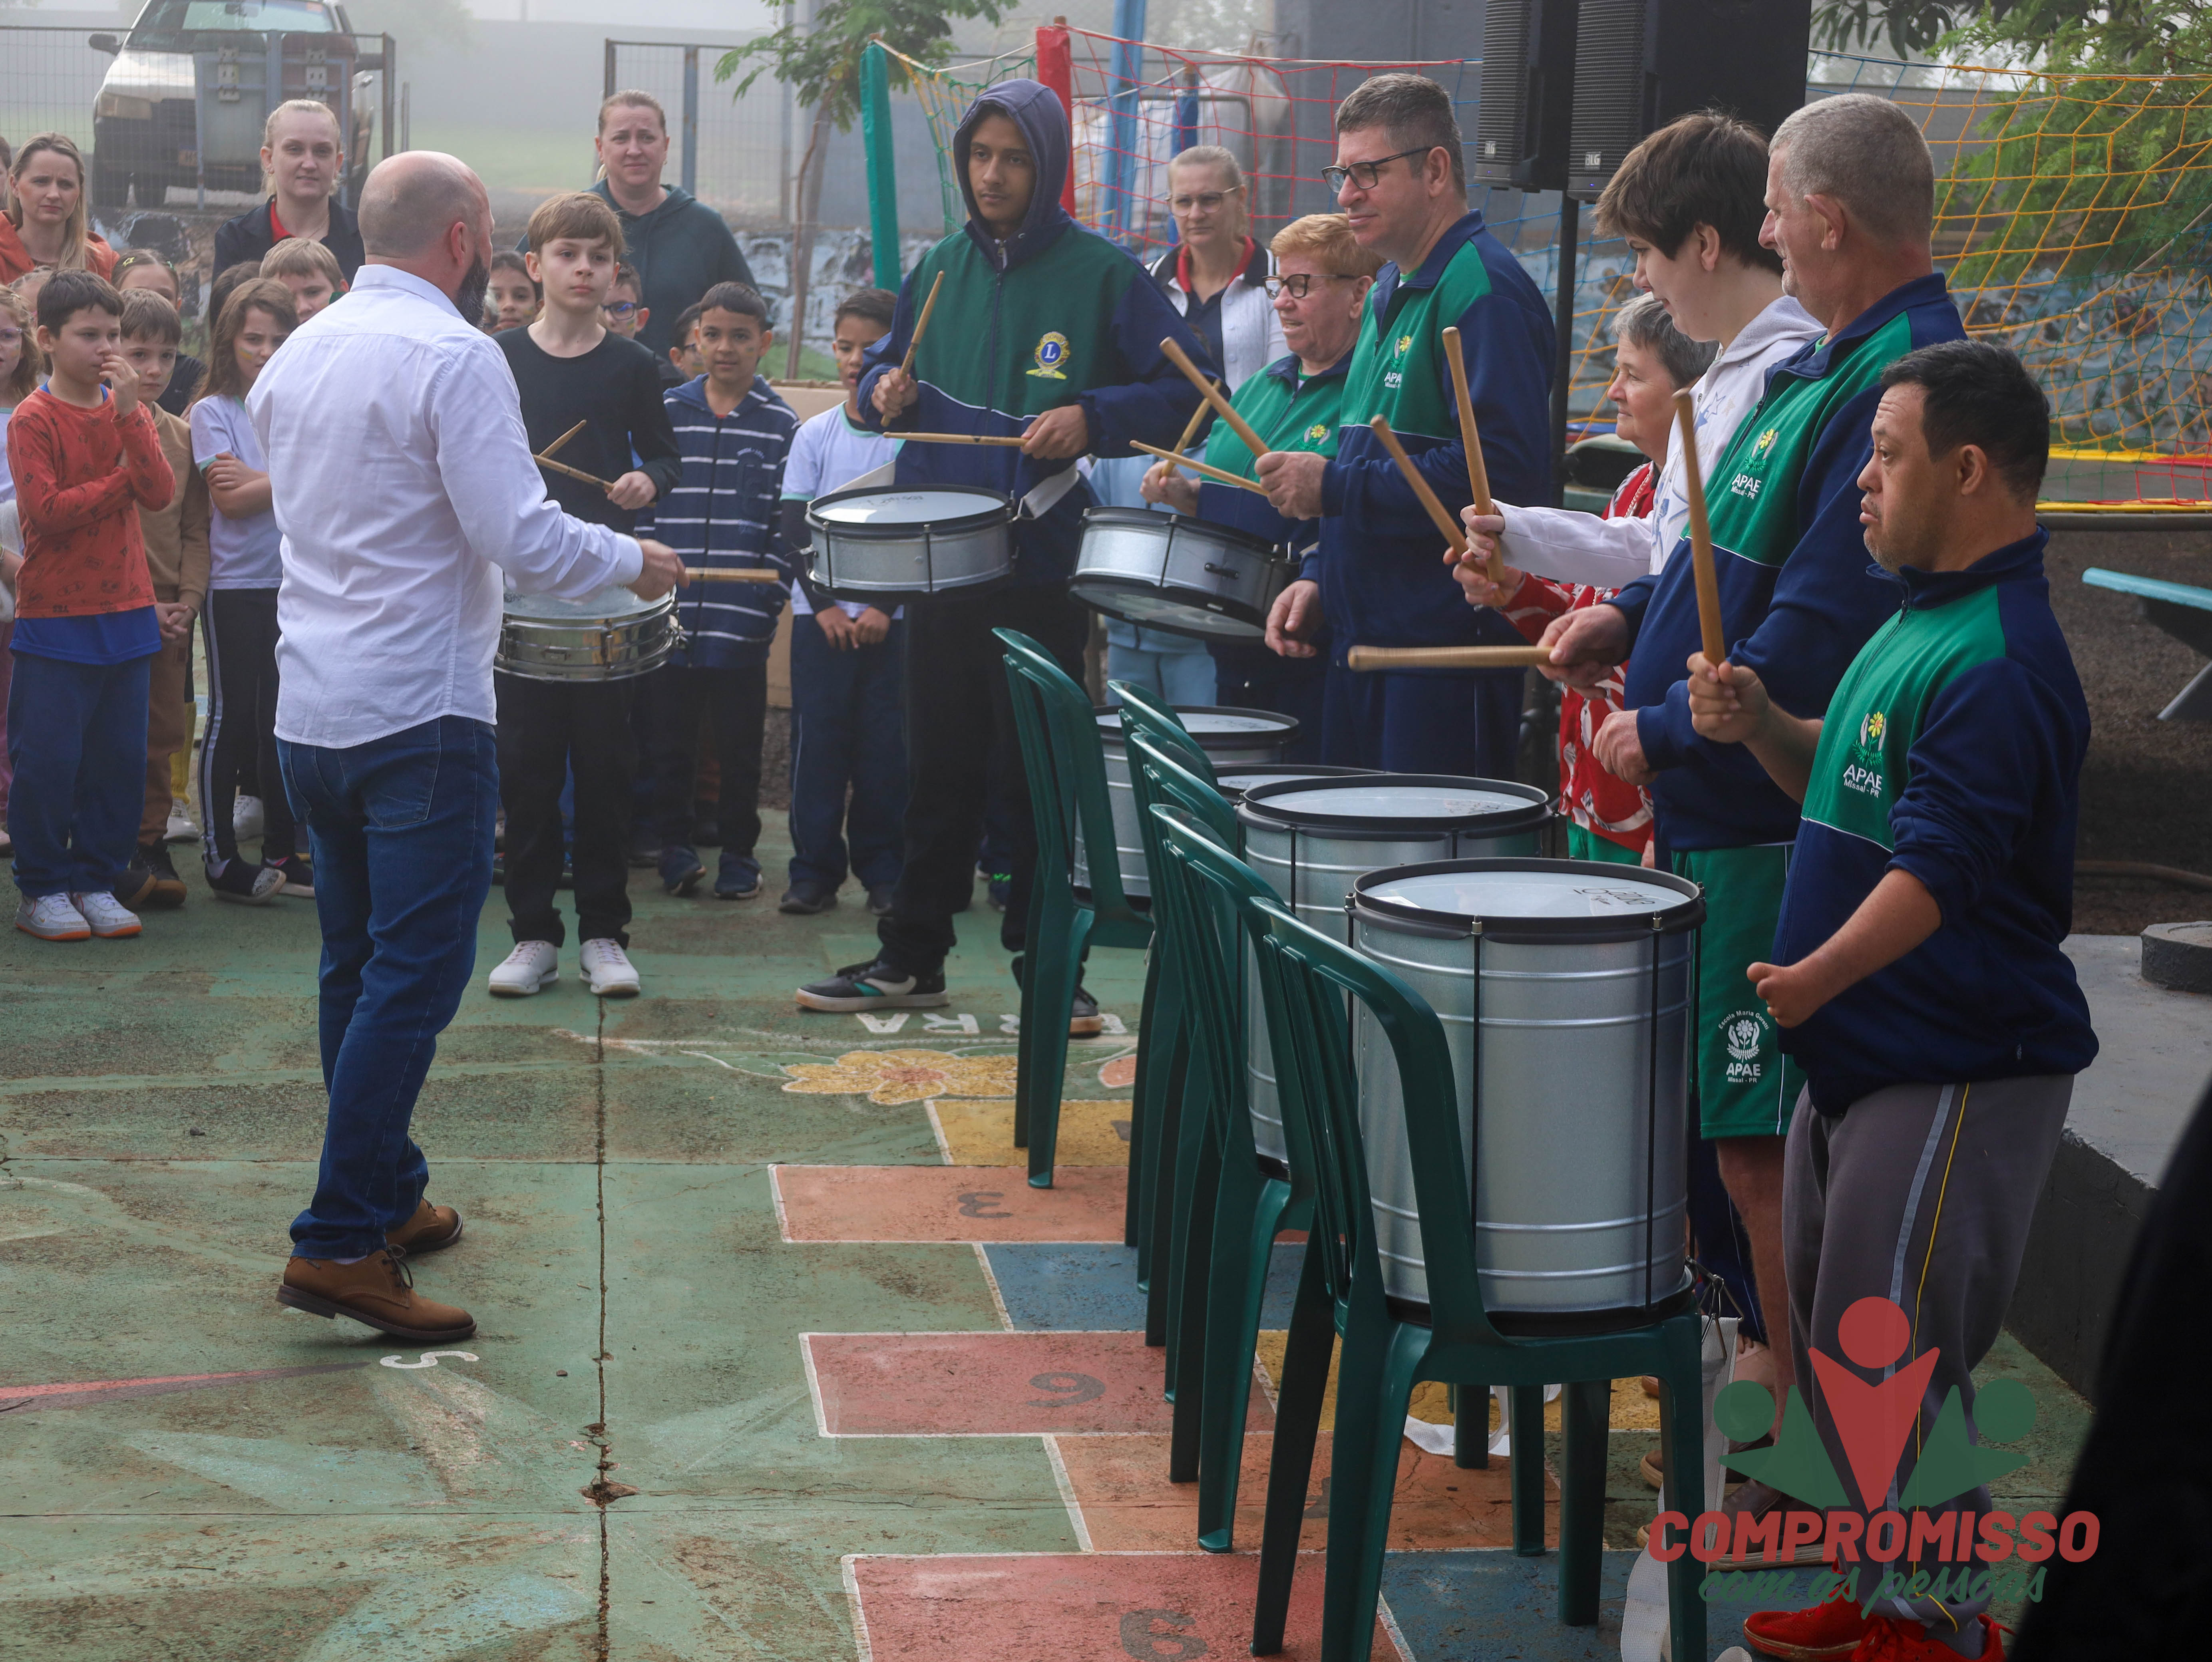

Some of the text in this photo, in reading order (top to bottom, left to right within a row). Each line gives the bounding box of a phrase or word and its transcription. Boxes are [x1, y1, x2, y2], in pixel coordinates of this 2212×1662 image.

[1044, 344, 1056, 359] L
[1732, 473, 1761, 493] APAE
[1731, 485, 1745, 495] Missal
[1747, 491, 1755, 499] PR
[1843, 764, 1883, 791] APAE
[1844, 778, 1866, 793] Missal
[1870, 787, 1879, 798] PR
[1719, 1014, 1735, 1030] Escola
[1726, 1062, 1761, 1076] APAE
